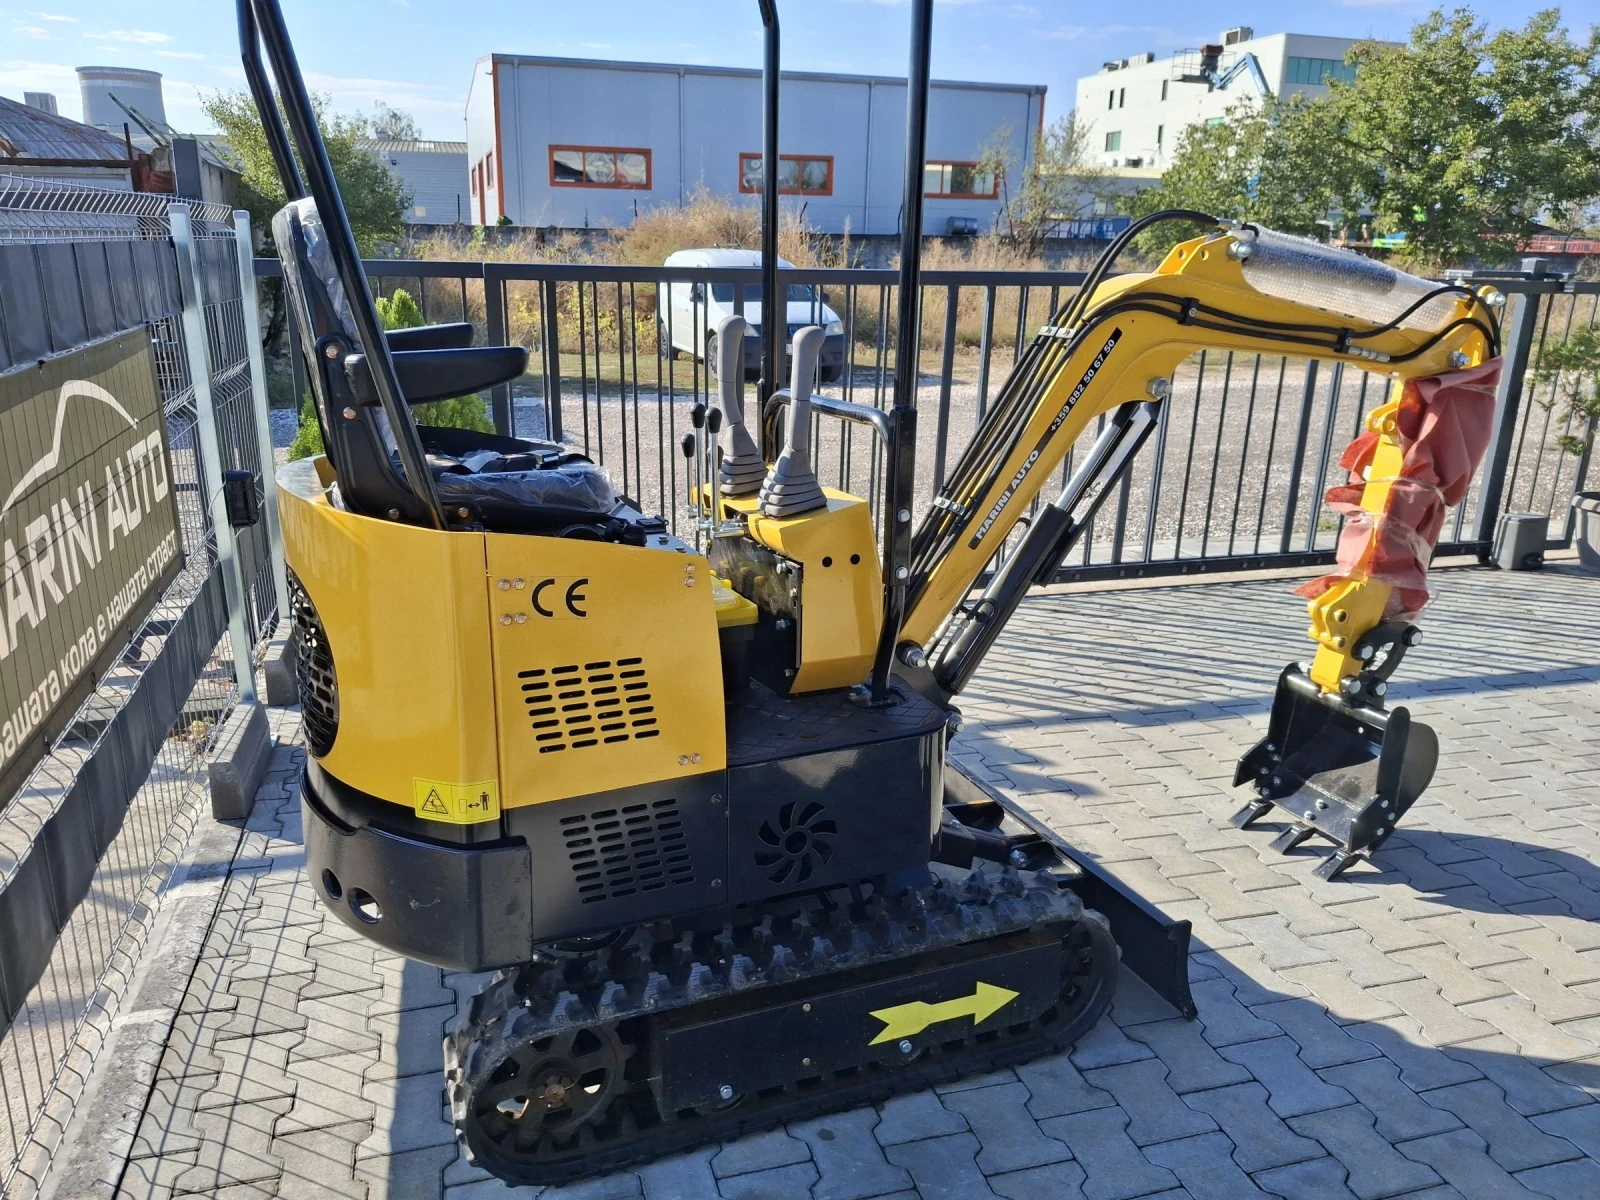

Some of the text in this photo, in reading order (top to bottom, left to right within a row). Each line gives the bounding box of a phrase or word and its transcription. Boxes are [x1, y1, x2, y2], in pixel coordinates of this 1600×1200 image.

[105, 429, 169, 552] AUTO
[976, 339, 1115, 540] MARINI AUTO +359 882 50 67 50
[0, 529, 177, 769] ашата кола е нашата страст
[531, 578, 589, 618] CE
